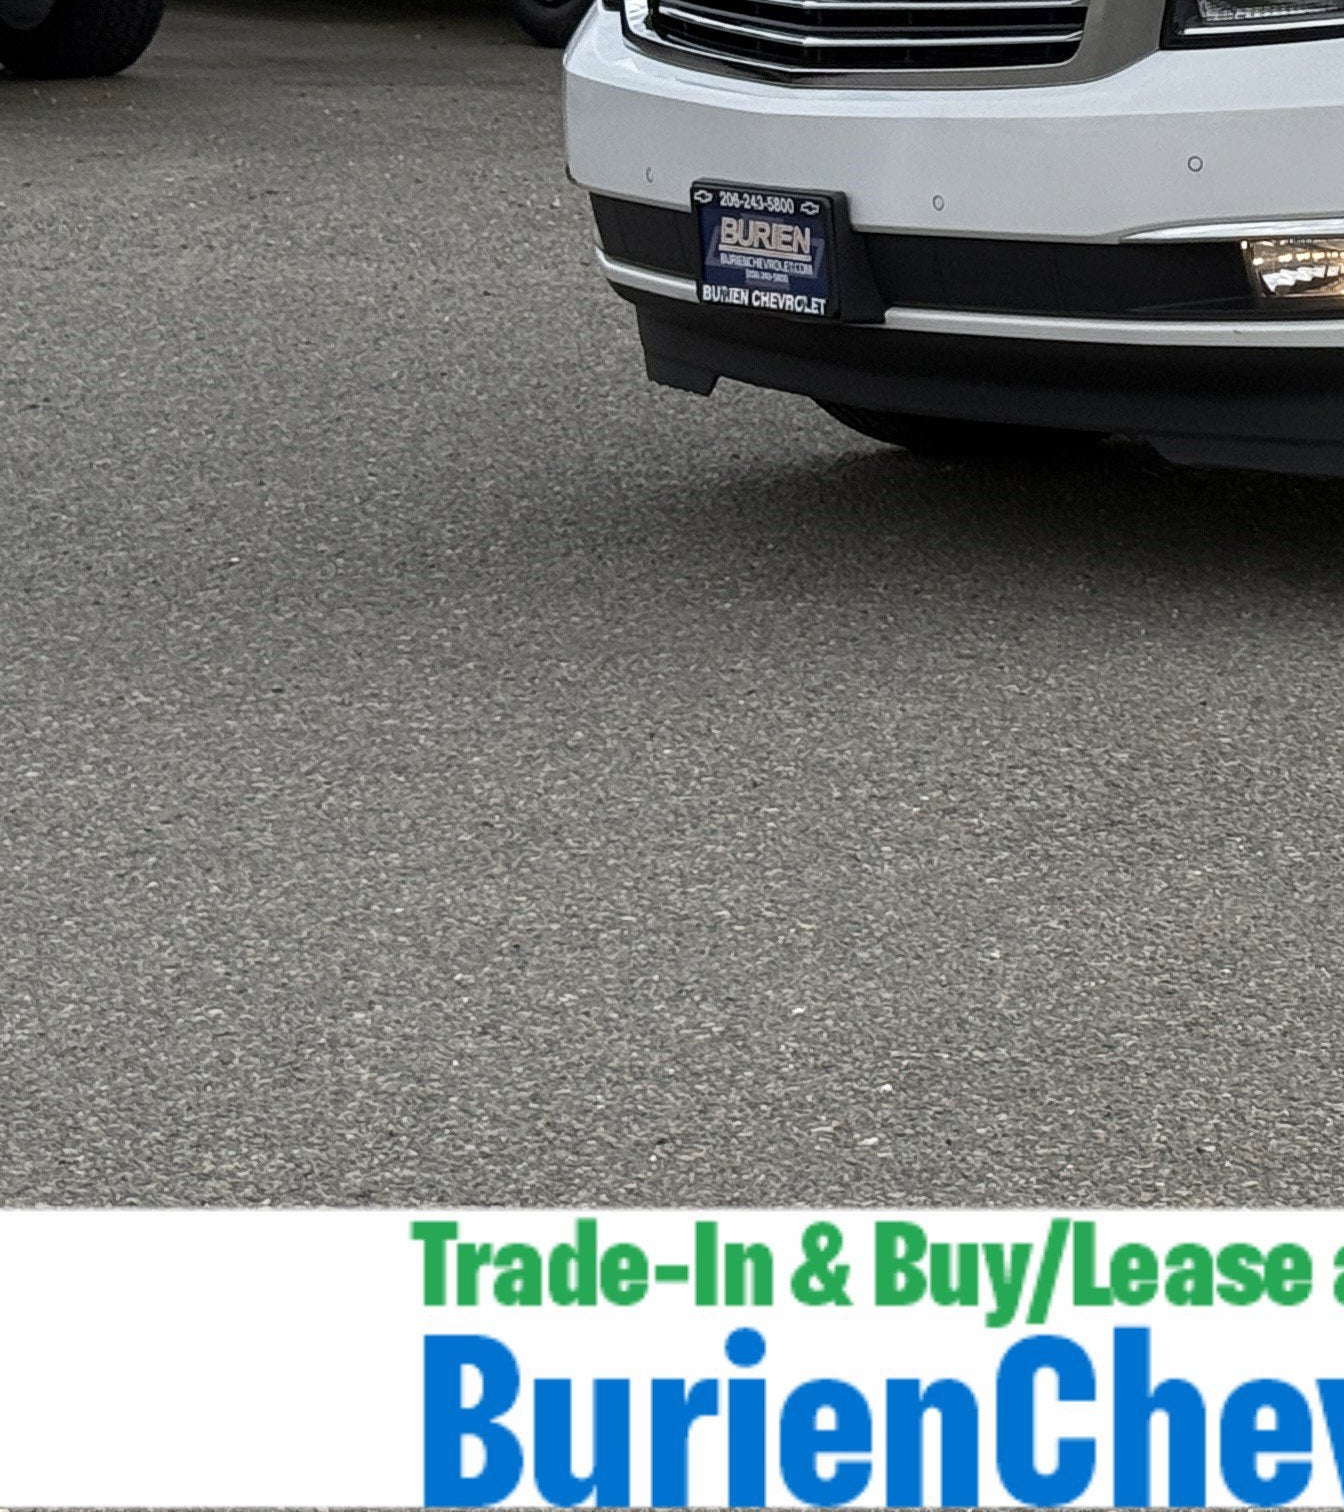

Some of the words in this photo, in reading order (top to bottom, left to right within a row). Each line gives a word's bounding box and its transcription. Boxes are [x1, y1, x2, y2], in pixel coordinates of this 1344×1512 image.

[719, 191, 795, 214] 206-243-5800
[720, 216, 811, 254] BURIEN
[702, 284, 749, 306] BURIEN
[751, 290, 827, 316] CHEVROLET
